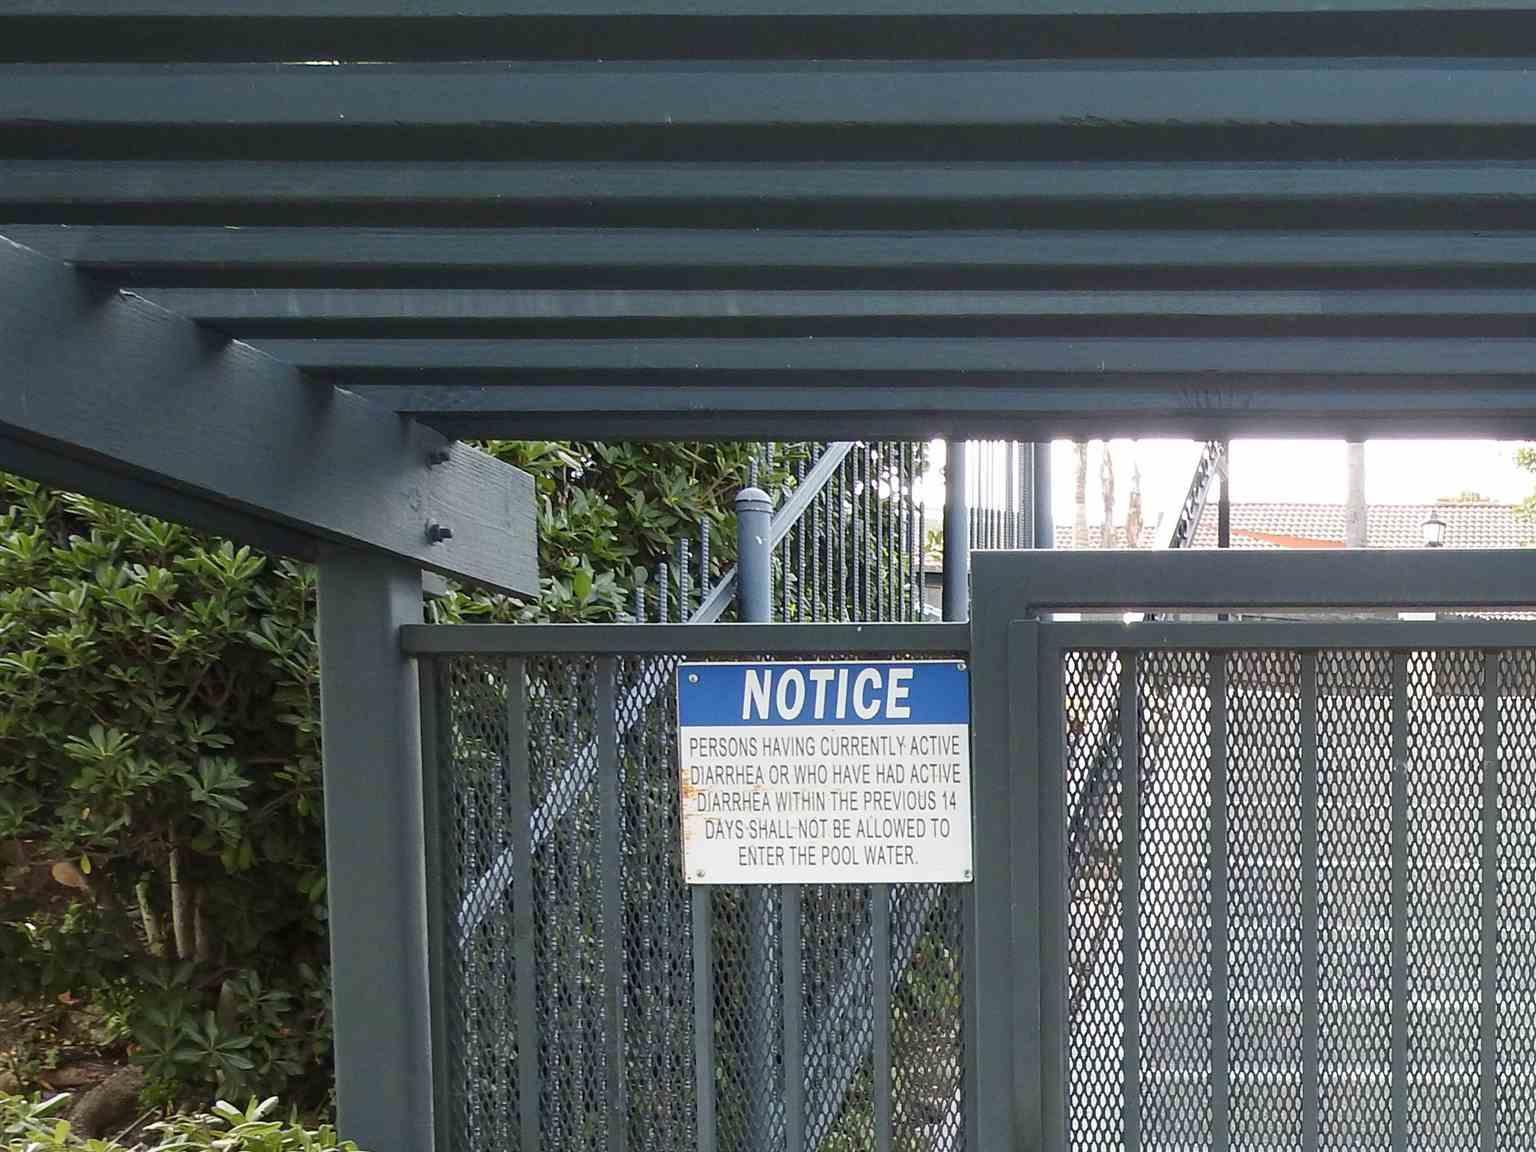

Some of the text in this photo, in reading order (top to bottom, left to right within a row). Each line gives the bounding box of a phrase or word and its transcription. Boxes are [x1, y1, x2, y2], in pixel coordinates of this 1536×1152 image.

[742, 668, 914, 720] NOTICE
[689, 735, 960, 757] PERSONS HAVING CURRENTLY ACTIVE
[691, 763, 961, 785] DIARRHEA OR WHO HAVE HAD ACTIVE
[697, 791, 957, 812] DIARRHEA WITHIN THE PREVIOUS 14
[705, 818, 950, 839] DAYS SHALL NOT BE ALLOWED TO
[738, 846, 919, 866] ENTER THE POOL WATER.
